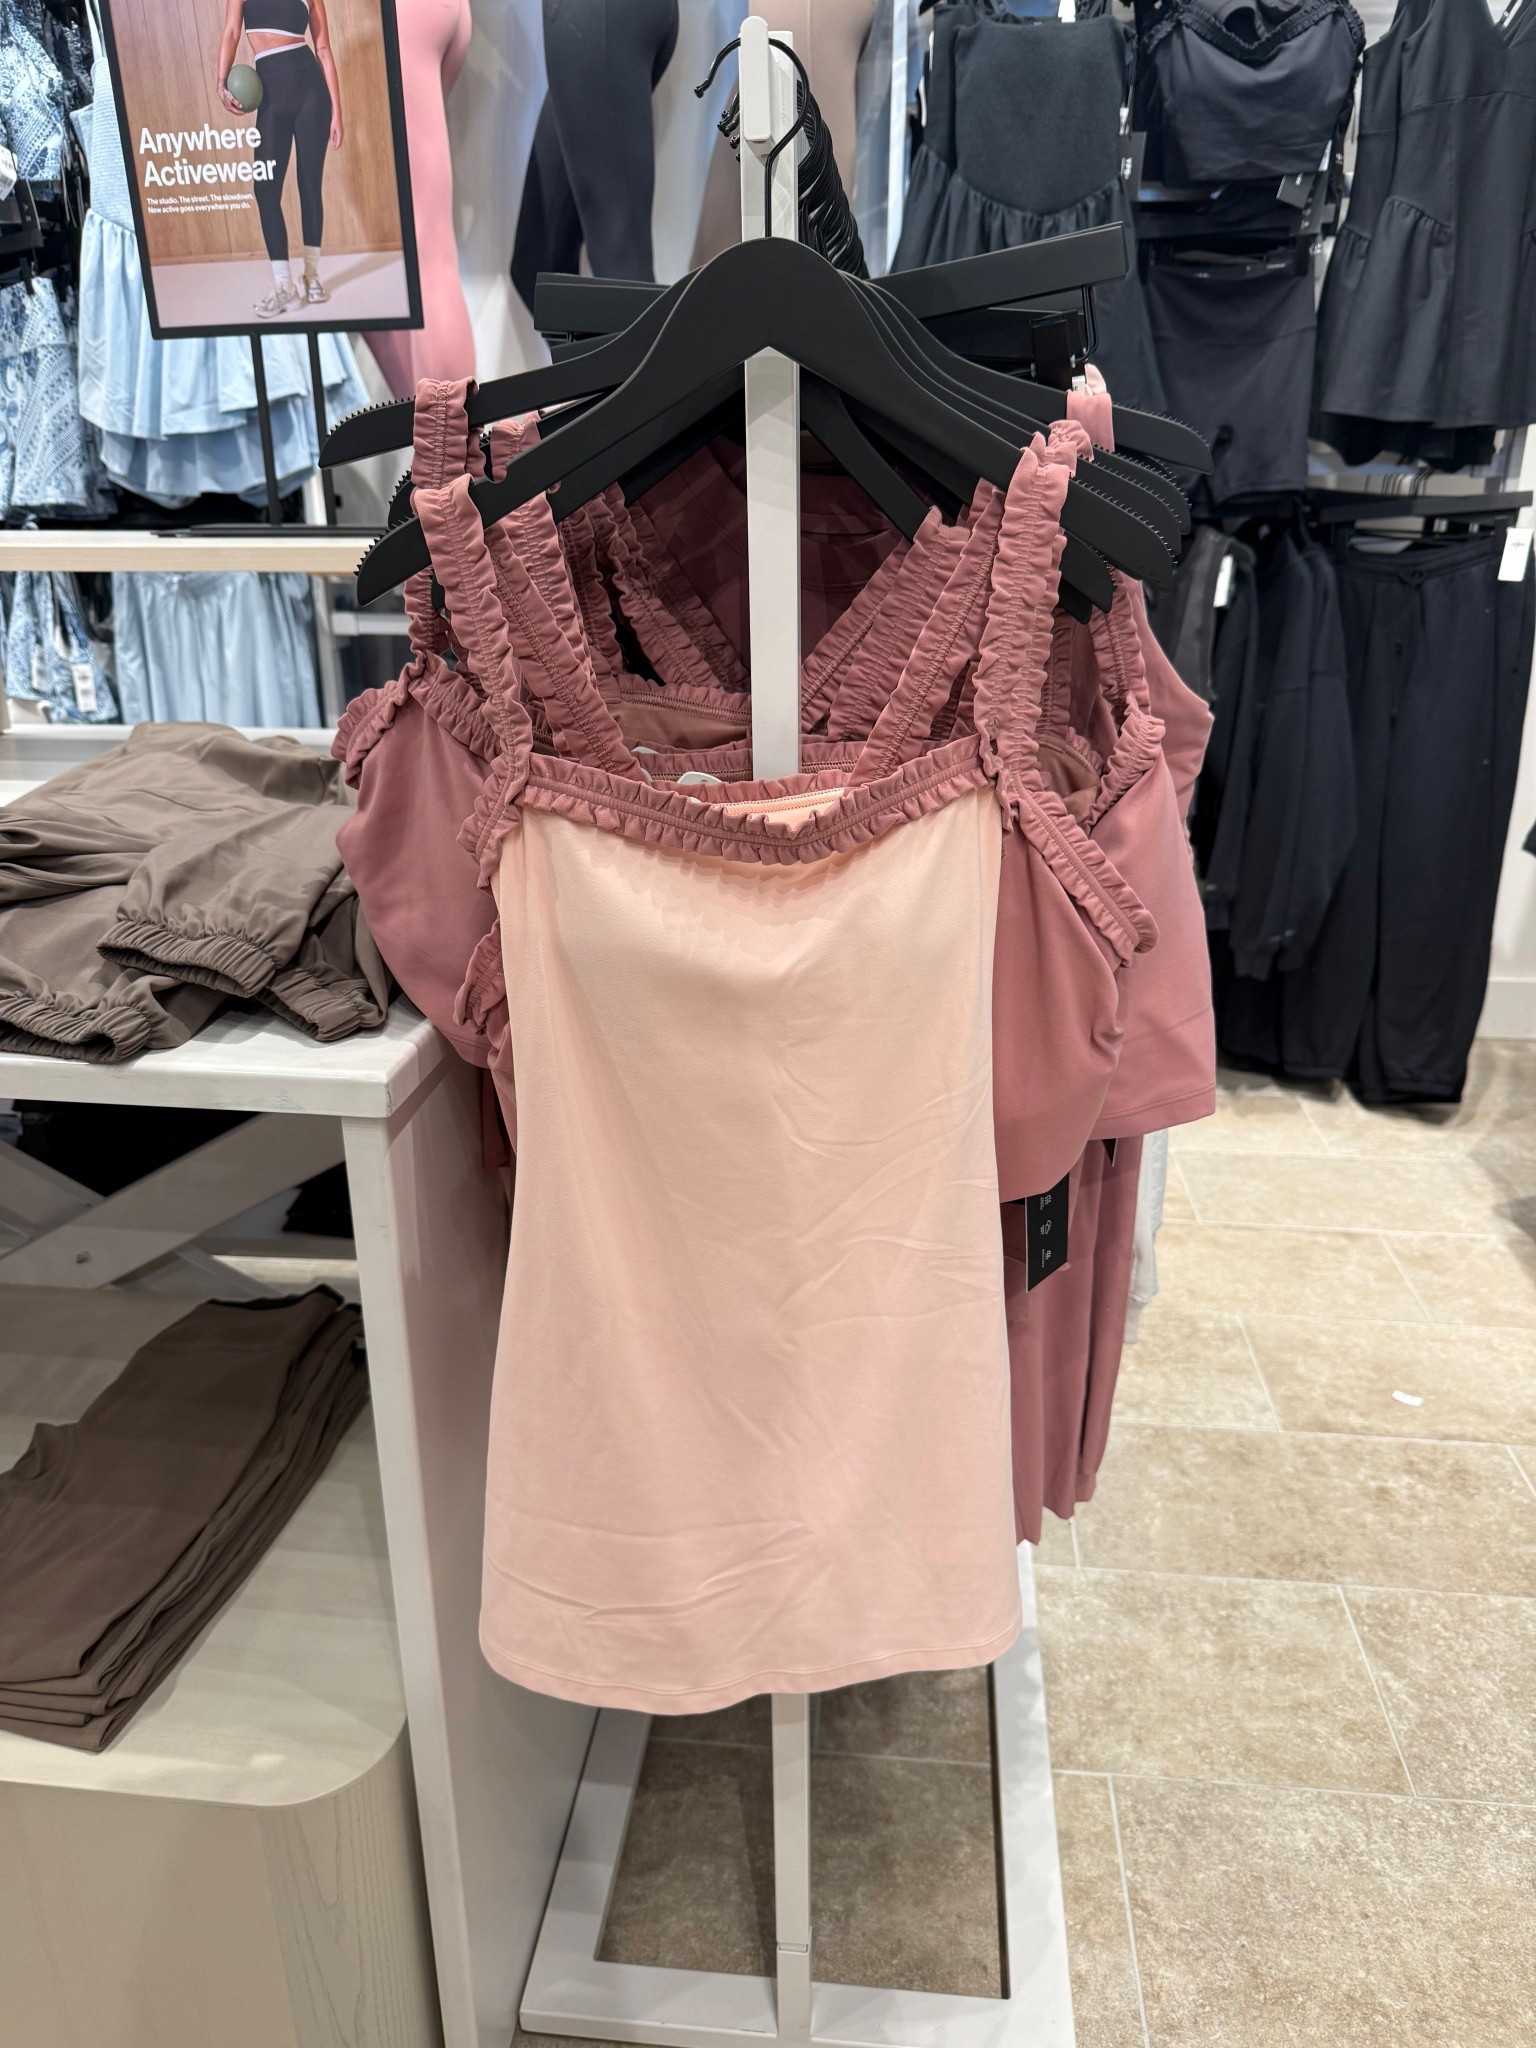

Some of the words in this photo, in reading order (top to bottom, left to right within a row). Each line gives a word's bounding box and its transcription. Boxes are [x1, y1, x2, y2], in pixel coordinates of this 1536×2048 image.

[139, 123, 262, 158] Anywhere
[144, 158, 277, 187] Activewear
[146, 197, 158, 205] The
[159, 196, 178, 205] studio.
[178, 195, 190, 204] The
[210, 193, 222, 201] The
[222, 193, 254, 201] slowdown.
[147, 206, 161, 214] New
[162, 205, 179, 213] active
[179, 205, 194, 214] goes
[194, 203, 229, 212] everywhere
[229, 203, 240, 211] you
[240, 201, 251, 209] do.
